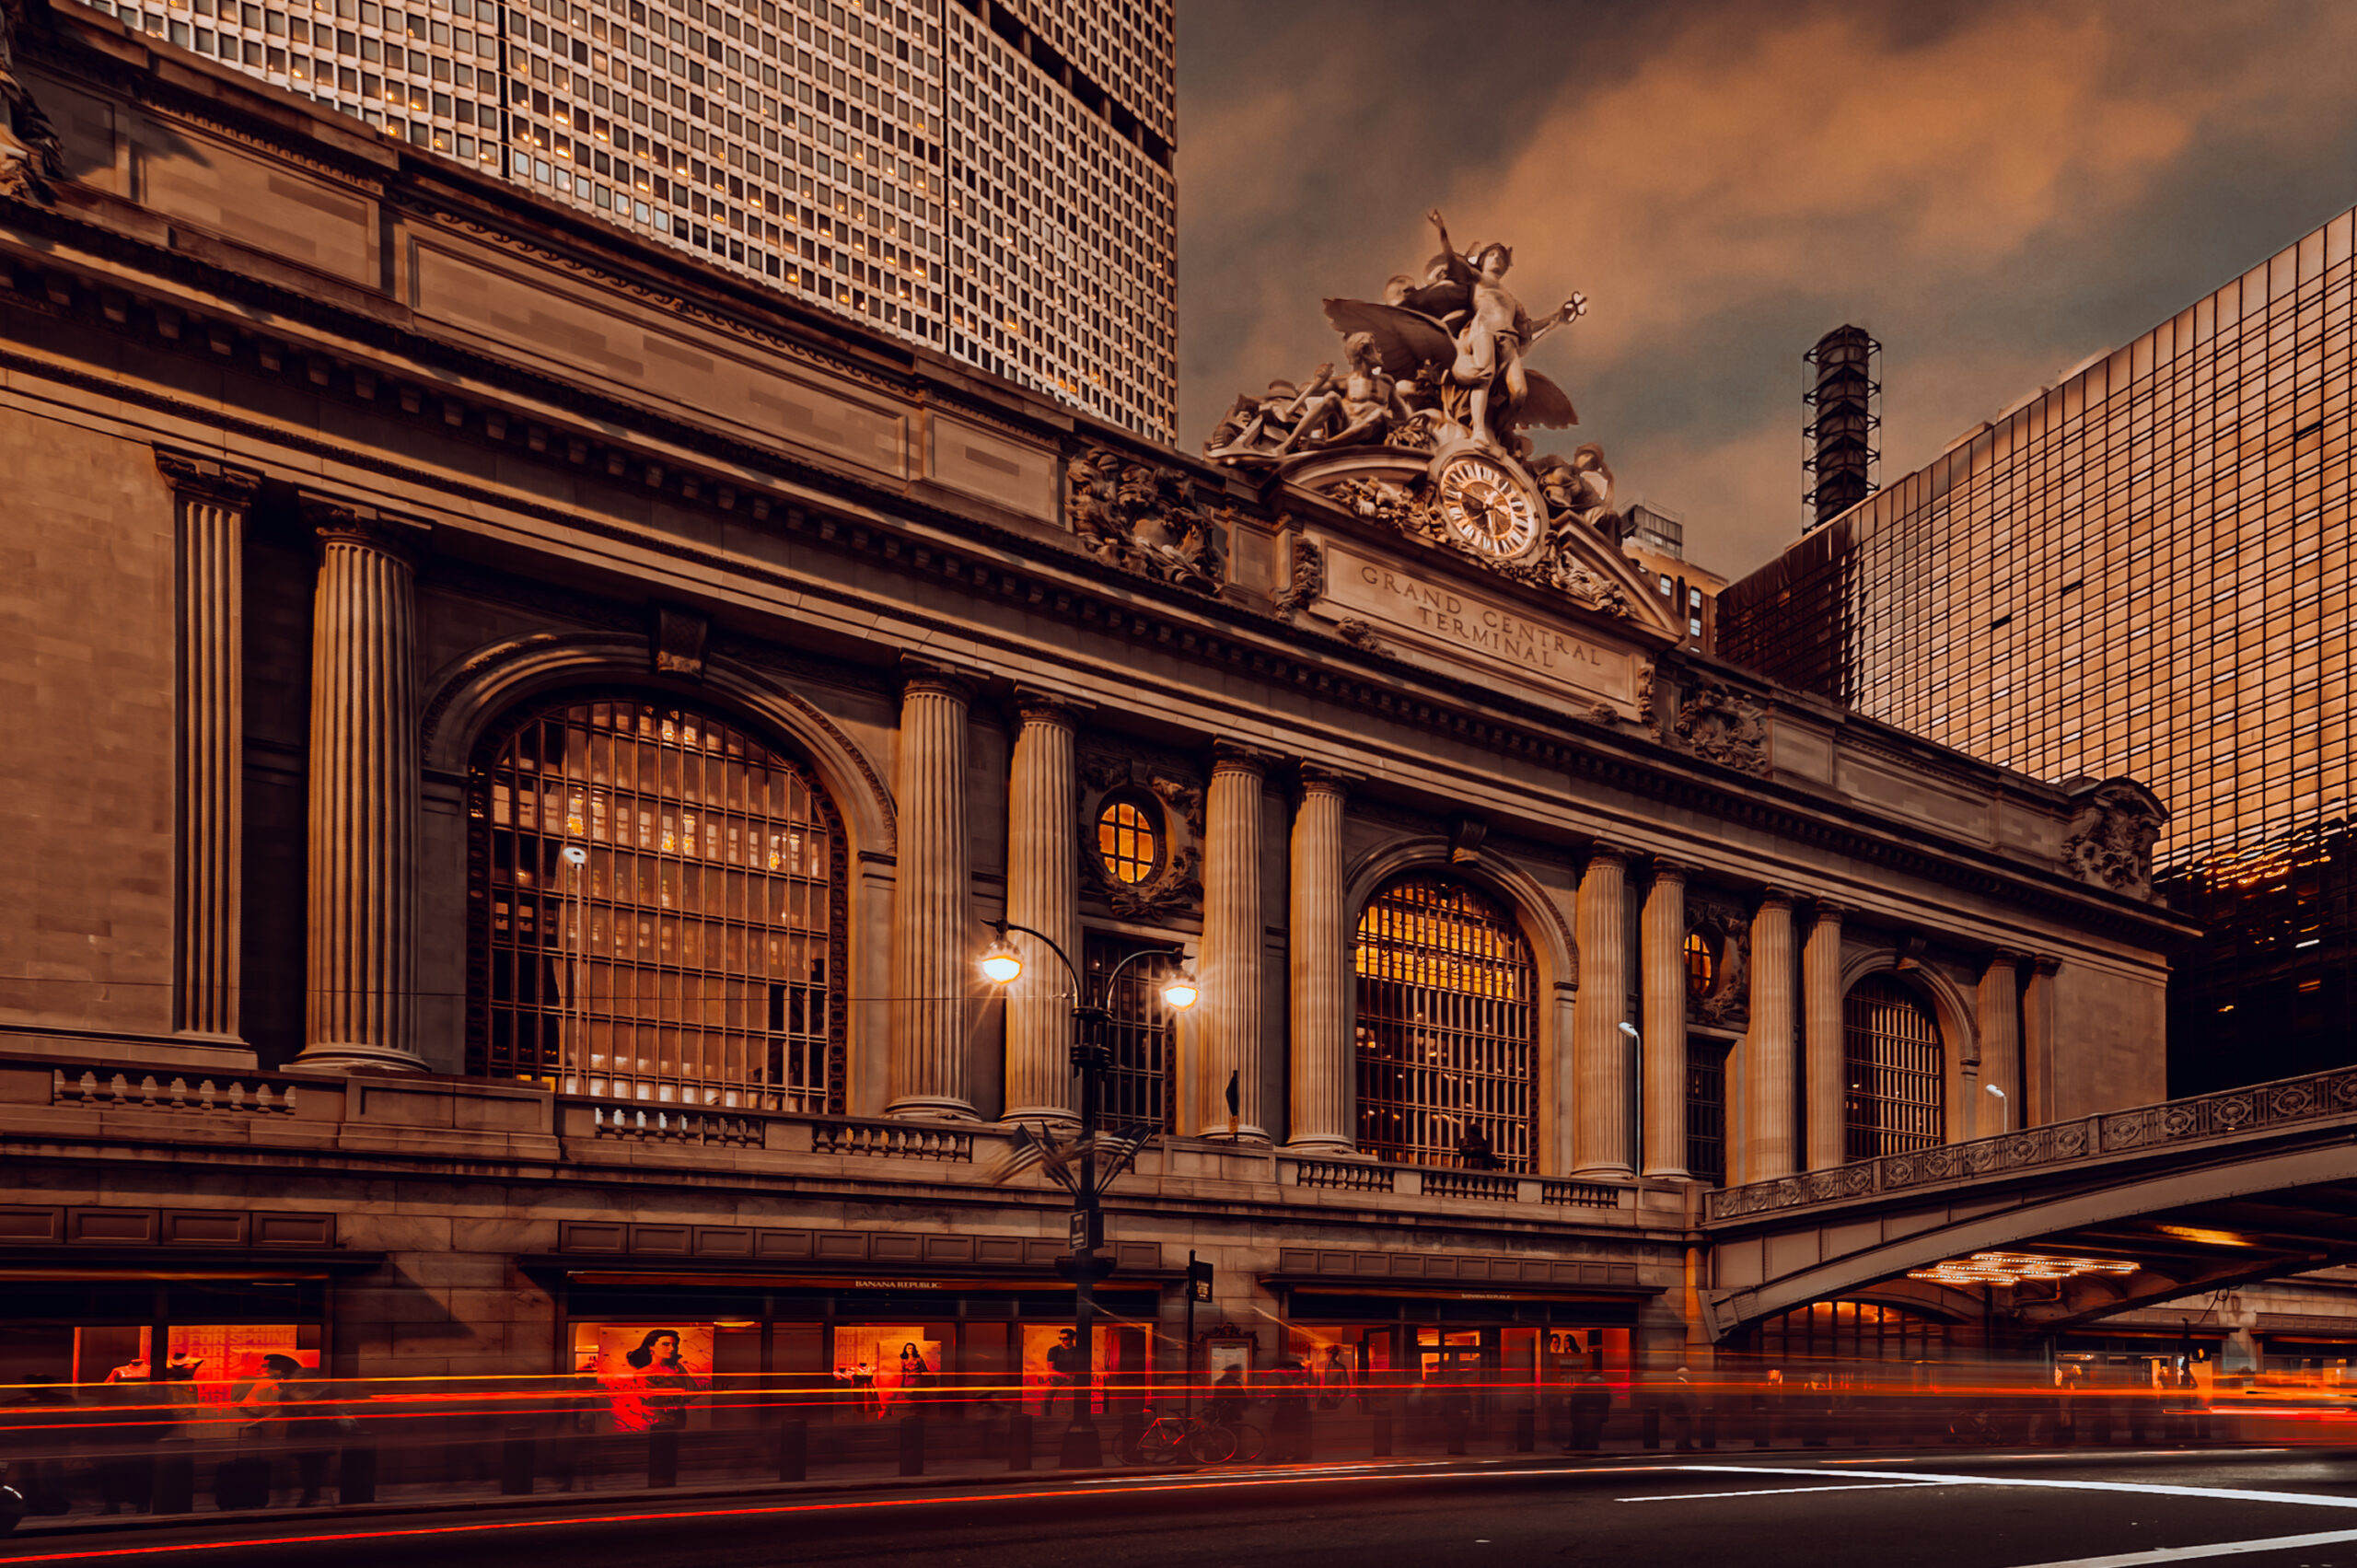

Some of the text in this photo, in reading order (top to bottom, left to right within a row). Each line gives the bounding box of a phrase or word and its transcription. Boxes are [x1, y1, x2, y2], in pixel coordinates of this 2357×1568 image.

[1361, 566, 1601, 666] GRAND CENTRAL
[1418, 606, 1554, 668] TERMINAL
[190, 1333, 226, 1345] FOR
